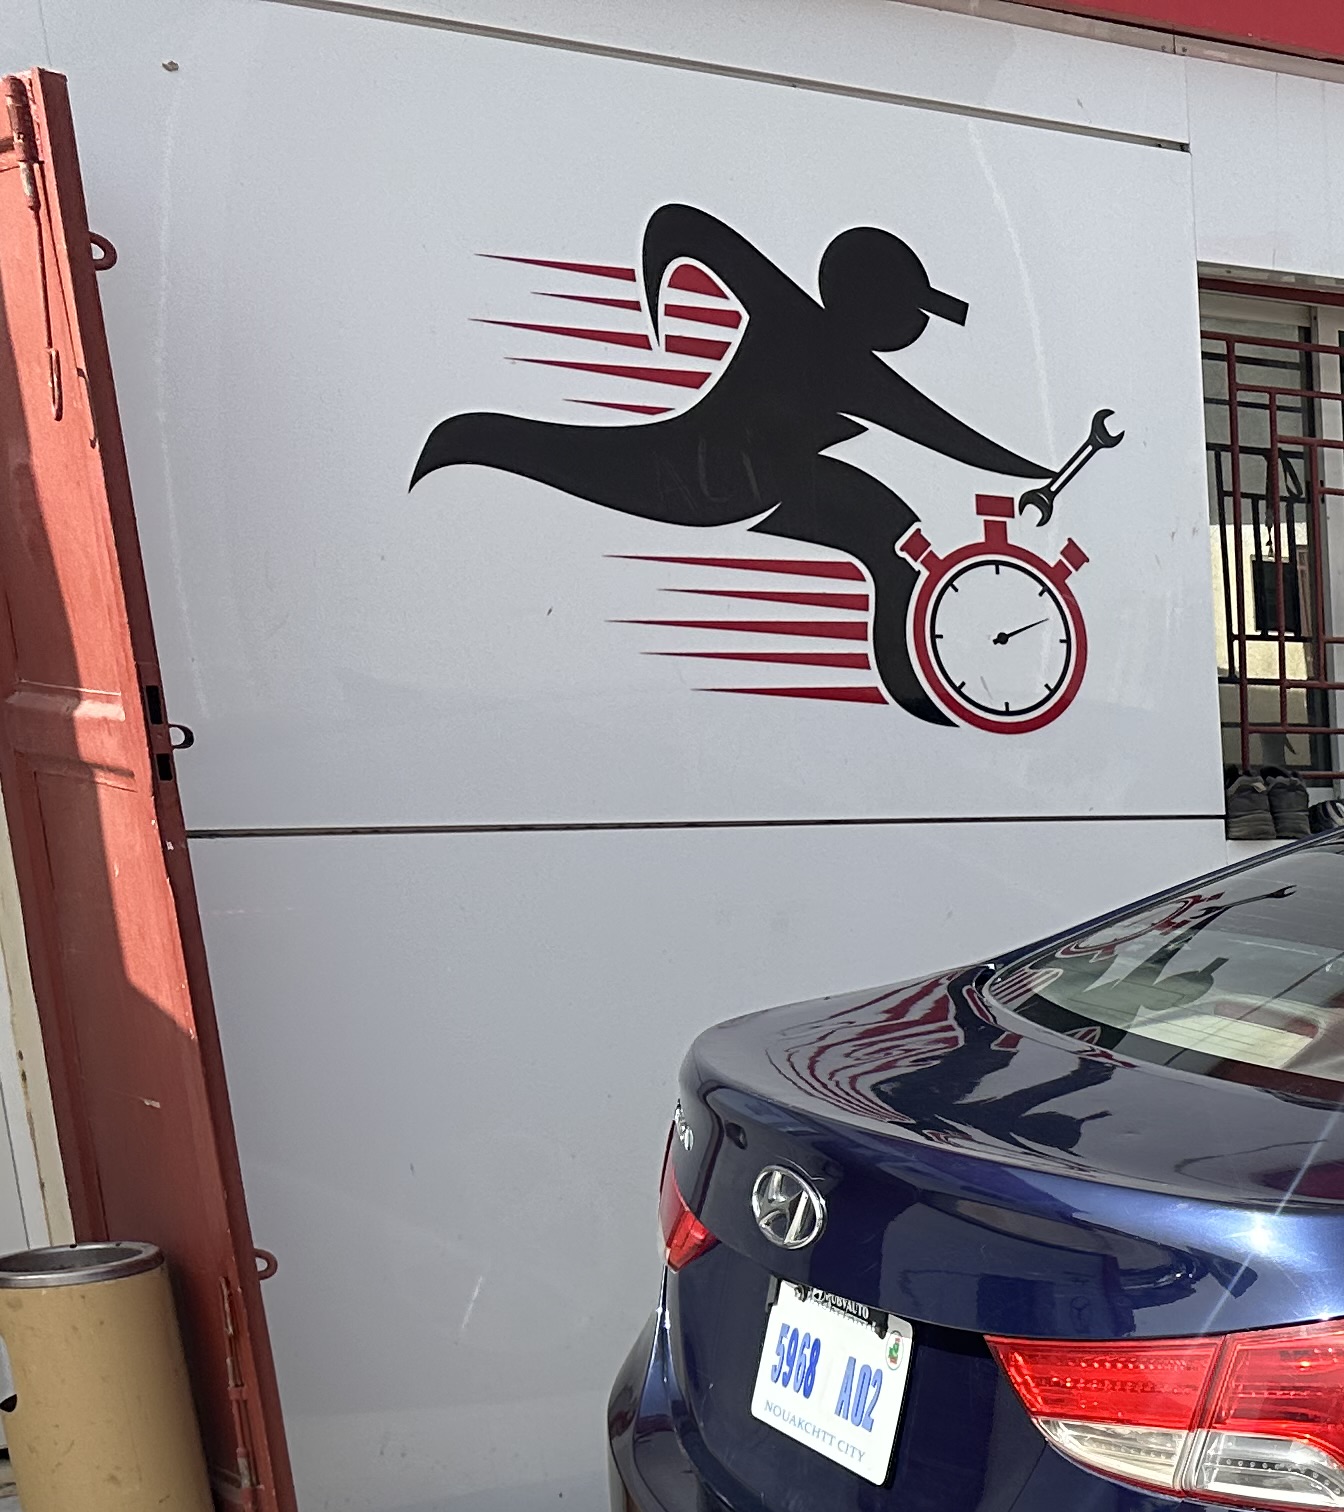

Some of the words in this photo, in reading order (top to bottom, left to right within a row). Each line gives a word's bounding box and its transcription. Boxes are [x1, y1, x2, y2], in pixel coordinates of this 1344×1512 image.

[771, 1322, 821, 1399] 5968
[834, 1356, 883, 1432] A02
[837, 1439, 866, 1462] CITY
